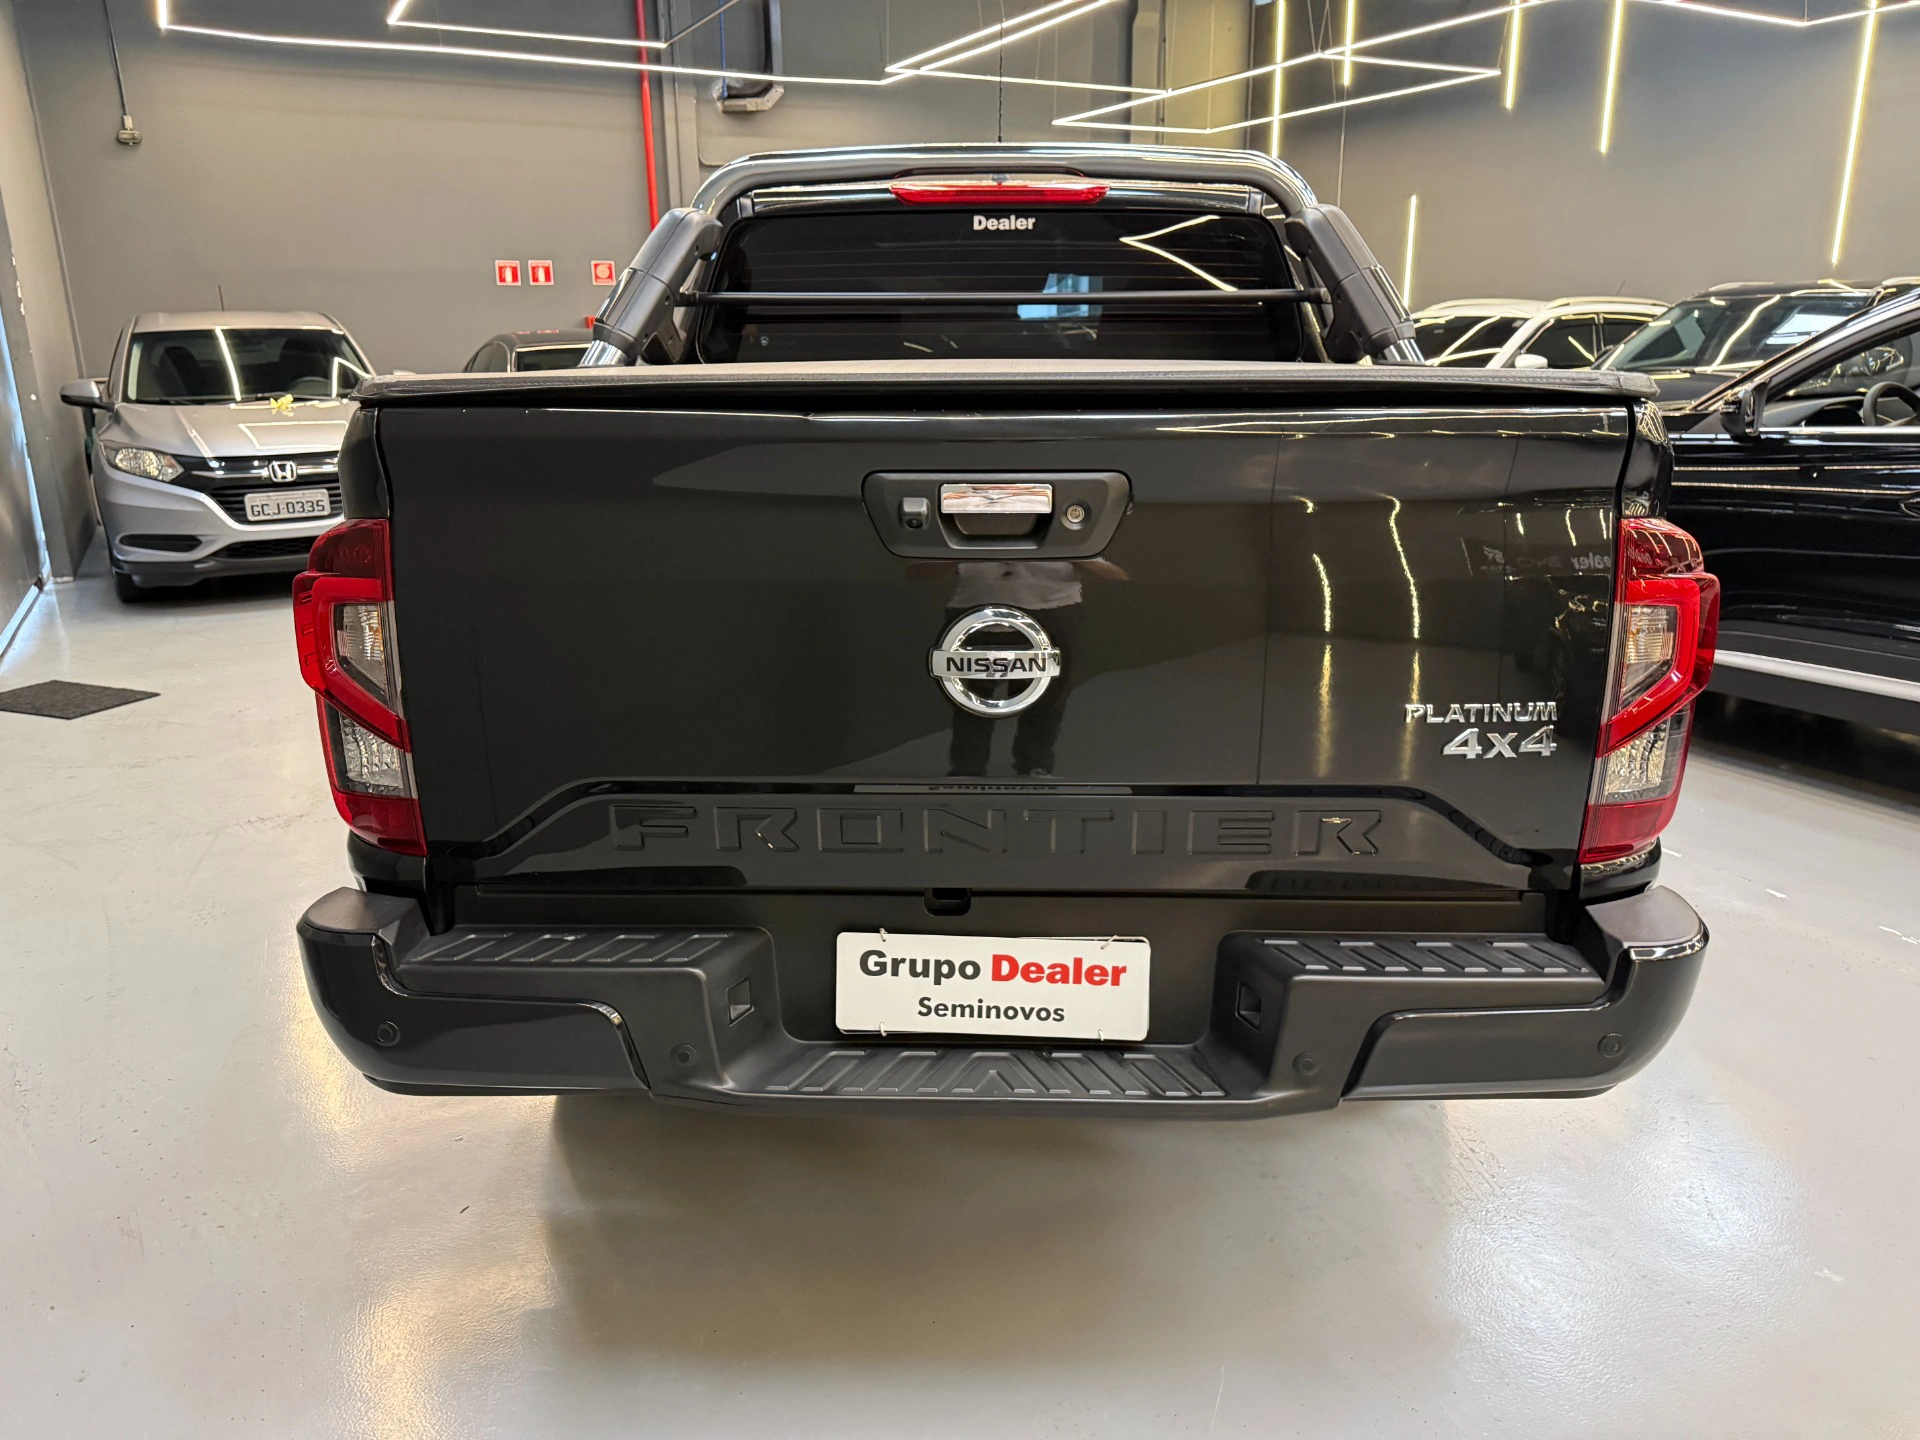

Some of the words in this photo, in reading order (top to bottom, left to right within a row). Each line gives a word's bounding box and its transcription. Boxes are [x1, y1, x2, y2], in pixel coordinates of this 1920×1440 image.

[973, 214, 1036, 231] Dealer
[945, 656, 1047, 673] NISSAN
[1404, 701, 1558, 724] PLATINUM
[609, 804, 1383, 858] FRONTIER
[859, 949, 982, 986] Grupo
[990, 953, 1128, 987] Dealer
[917, 996, 1066, 1022] Seminovos
